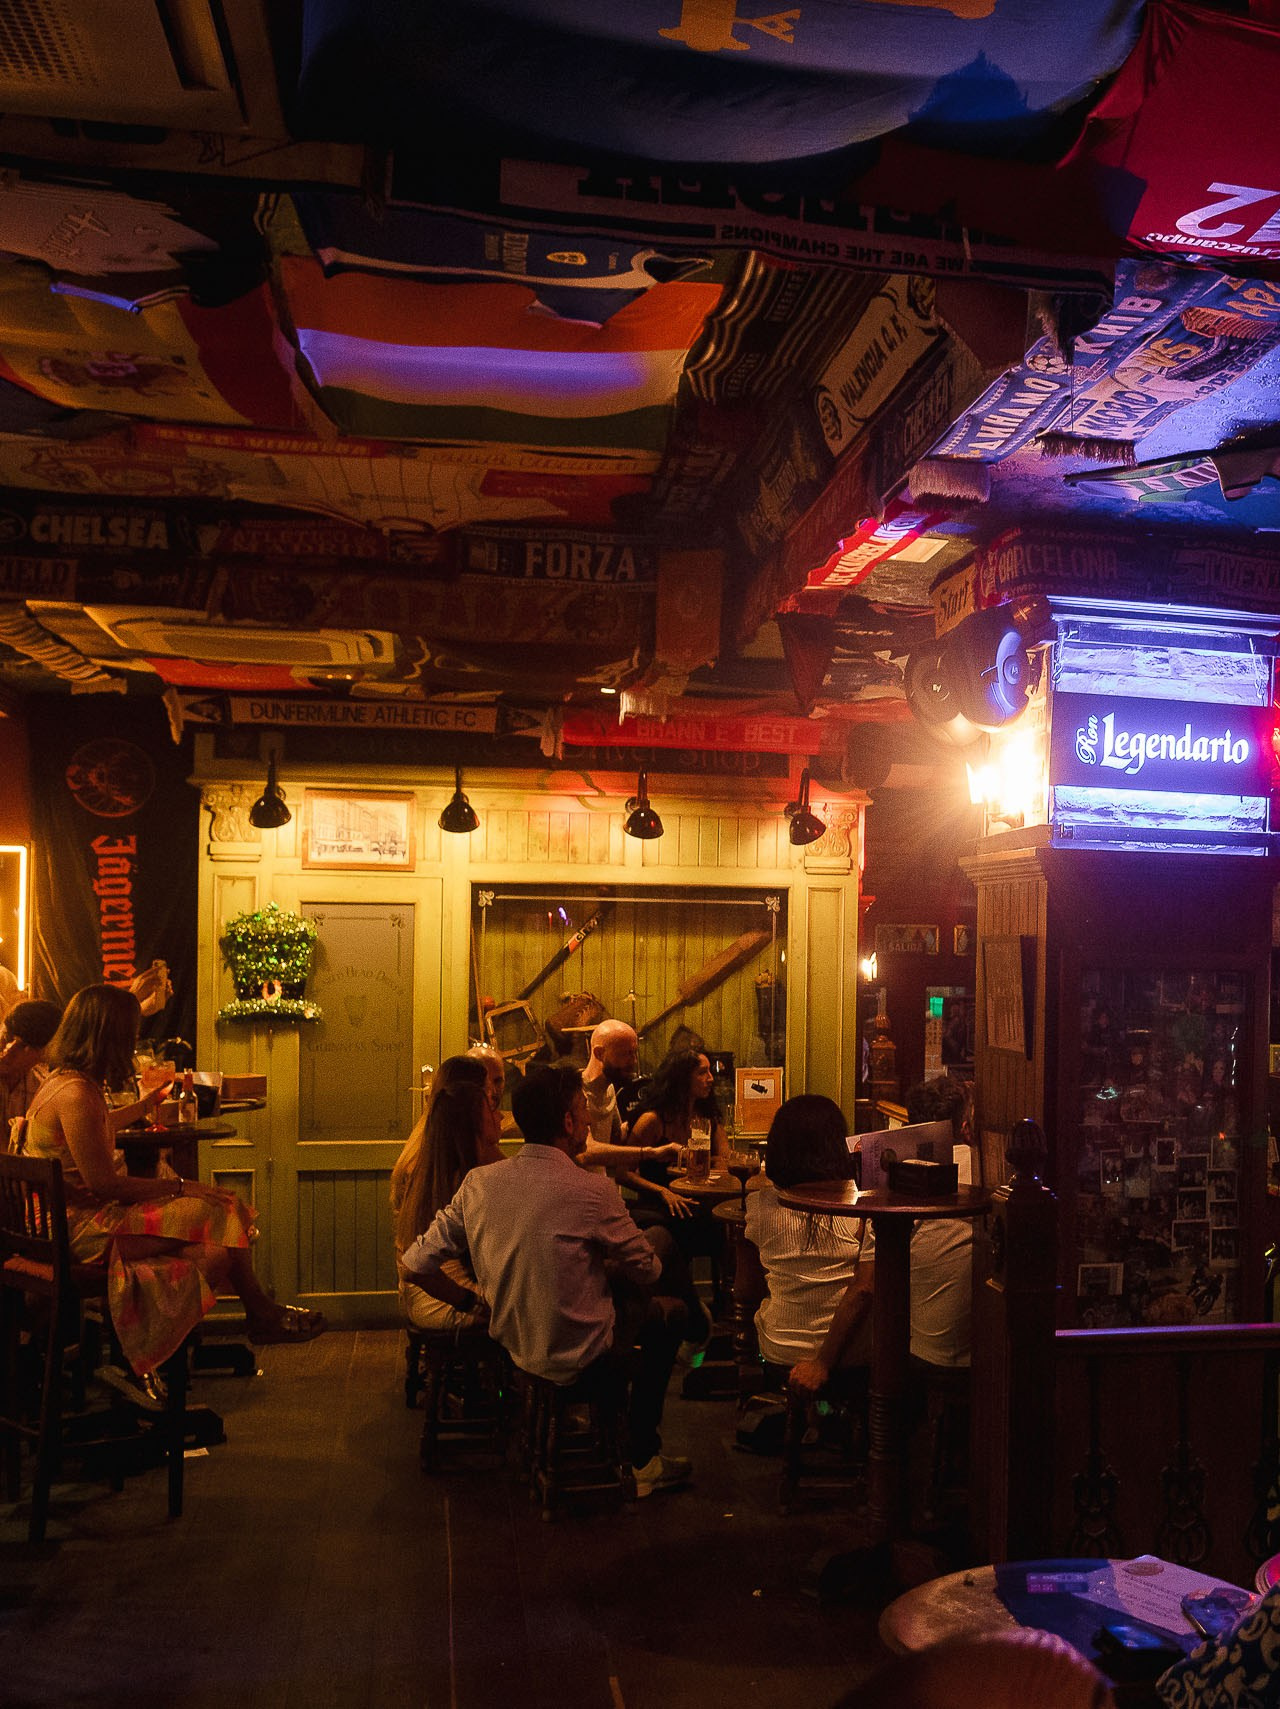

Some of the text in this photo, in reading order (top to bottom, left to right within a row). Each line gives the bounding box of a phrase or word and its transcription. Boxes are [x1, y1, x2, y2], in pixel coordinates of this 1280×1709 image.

[30, 512, 170, 549] CHELSEA
[524, 541, 638, 582] FORZA
[998, 543, 1119, 584] BARCELONA
[250, 701, 477, 728] DUNFERMLINE ATHLETIC FC
[743, 723, 799, 743] BEST
[1075, 712, 1250, 775] Ron Legendario
